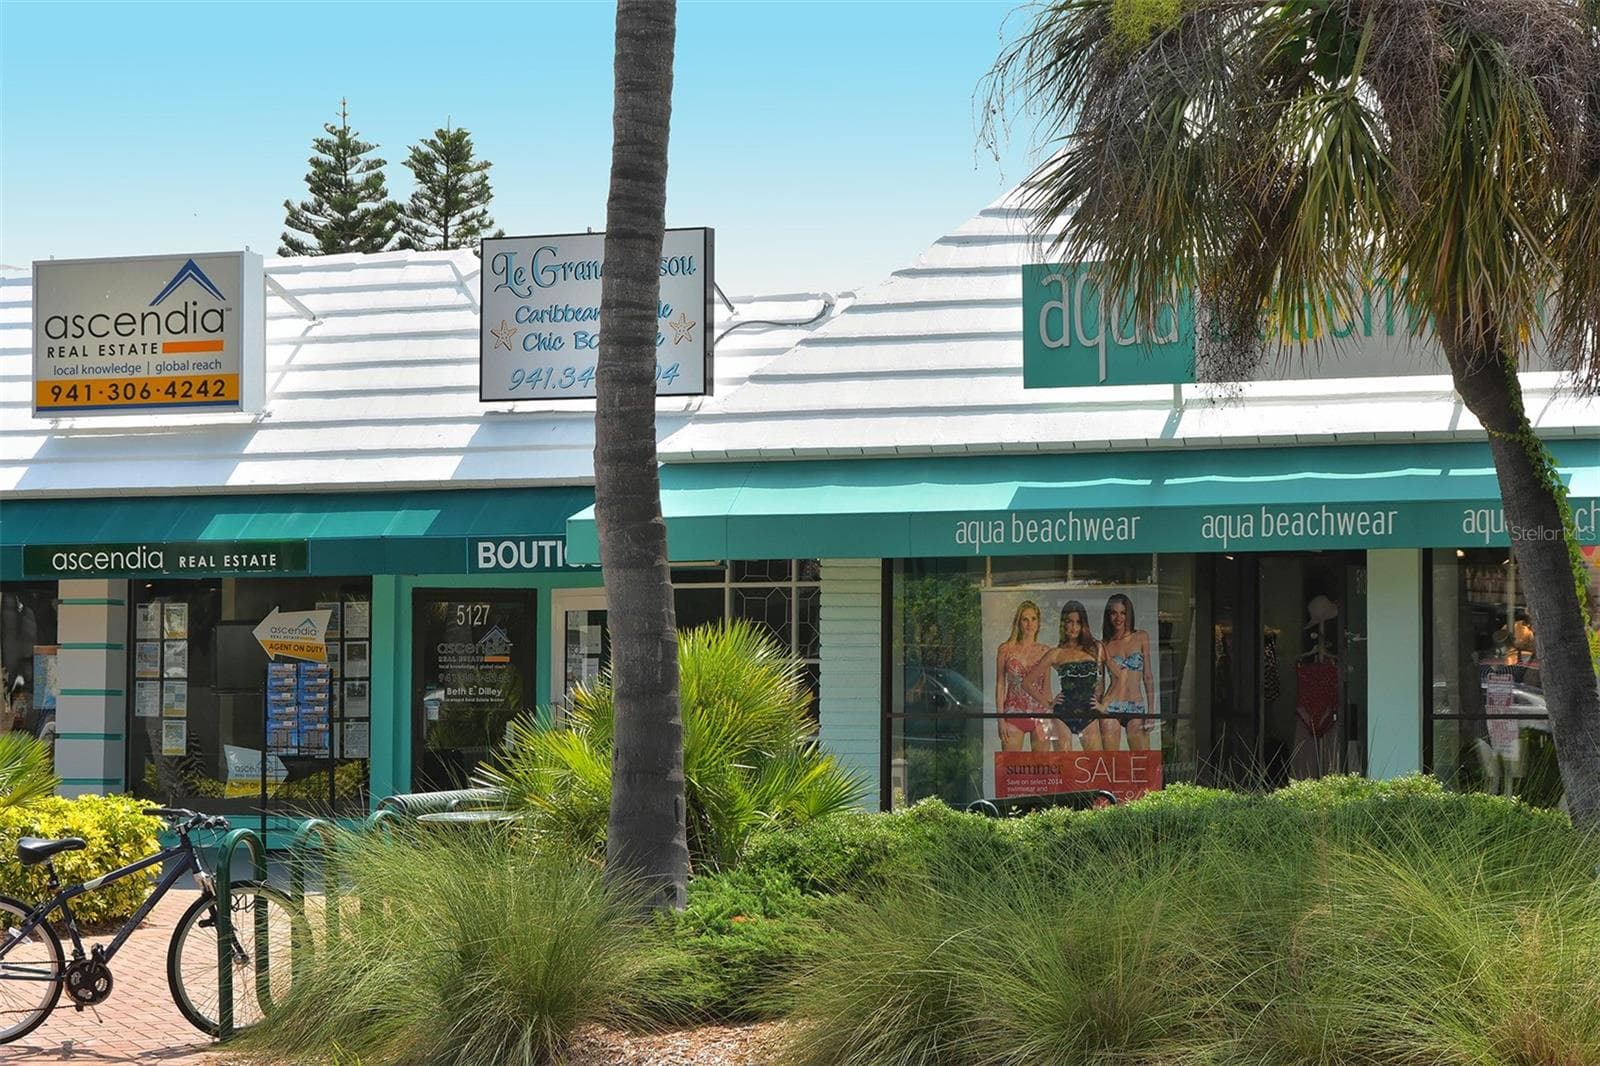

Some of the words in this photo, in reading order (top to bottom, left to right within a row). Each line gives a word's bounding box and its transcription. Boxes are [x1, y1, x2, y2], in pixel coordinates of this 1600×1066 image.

[491, 251, 532, 299] Le
[531, 245, 603, 289] Gran
[659, 255, 697, 277] sou
[44, 300, 225, 341] ascendia
[1039, 272, 1179, 383] aqua
[47, 345, 88, 359] REAL
[98, 342, 159, 357] ESTATE
[522, 330, 565, 353] Chic
[53, 364, 79, 376] local
[81, 362, 142, 377] knowledge
[155, 359, 190, 375] global
[192, 358, 222, 371] reach
[955, 519, 1005, 554] aqua
[1011, 511, 1141, 544] beachwear
[1201, 513, 1254, 549] aqua
[1260, 505, 1398, 538] beachwear
[1462, 508, 1508, 545] aqu
[52, 545, 164, 571] ascendia
[179, 555, 216, 568] REAL
[223, 553, 277, 568] ESTATE
[477, 540, 598, 569] BOUTI
[456, 604, 490, 626] 5127
[270, 626, 317, 636] ascendia
[268, 643, 292, 651] AGENT
[292, 644, 305, 652] ON
[305, 645, 324, 654] DUTY
[446, 687, 467, 696] Beth
[478, 687, 503, 697] Dilley
[1006, 763, 1064, 775] summer
[1074, 756, 1149, 784] SALE
